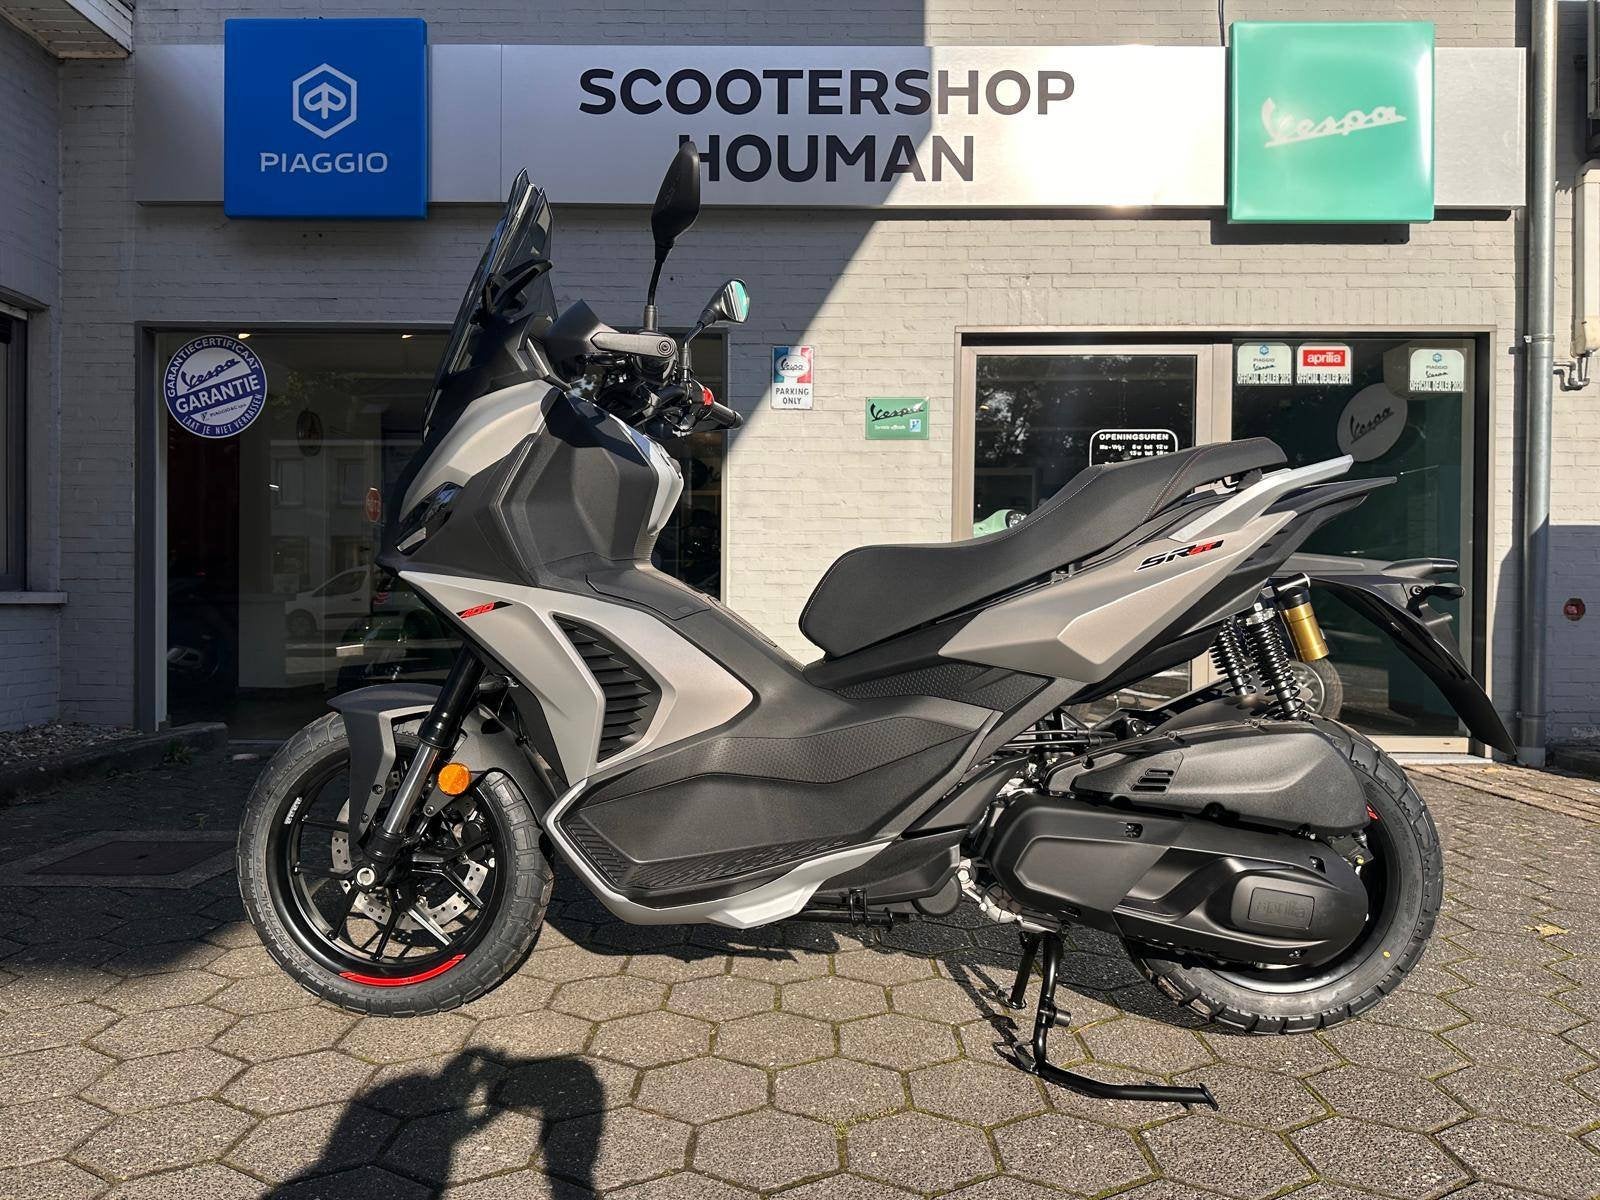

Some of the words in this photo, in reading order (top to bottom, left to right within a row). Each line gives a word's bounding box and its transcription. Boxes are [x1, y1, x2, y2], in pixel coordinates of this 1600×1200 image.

[579, 68, 1075, 116] SCOOTERSHOP
[1261, 97, 1407, 148] Vespa
[260, 152, 388, 173] PIAGGIO
[678, 134, 974, 183] HOUMAN
[167, 337, 260, 398] GARANTIECERTIFICAAT
[781, 357, 804, 371] Vespa
[1307, 351, 1342, 365] aprilia
[181, 358, 241, 391] Vespa
[1237, 373, 1258, 384] OFFICIAL
[1260, 373, 1279, 384] DEALER
[1296, 373, 1318, 384] OFFICIAL
[1319, 373, 1339, 384] DEALER
[175, 374, 261, 414] GARANTIE
[775, 387, 810, 396] PARKING
[1409, 381, 1431, 392] OFFICIAL
[1432, 381, 1451, 392] DEALER
[782, 397, 802, 405] ONLY
[182, 415, 199, 431] LAAT
[202, 425, 211, 435] JE
[215, 425, 233, 435] NIET
[234, 394, 263, 427] VERRASSEN
[870, 402, 926, 422] Vespa
[1350, 406, 1395, 445] Vespa
[1099, 433, 1169, 441] OPENINGSUREN
